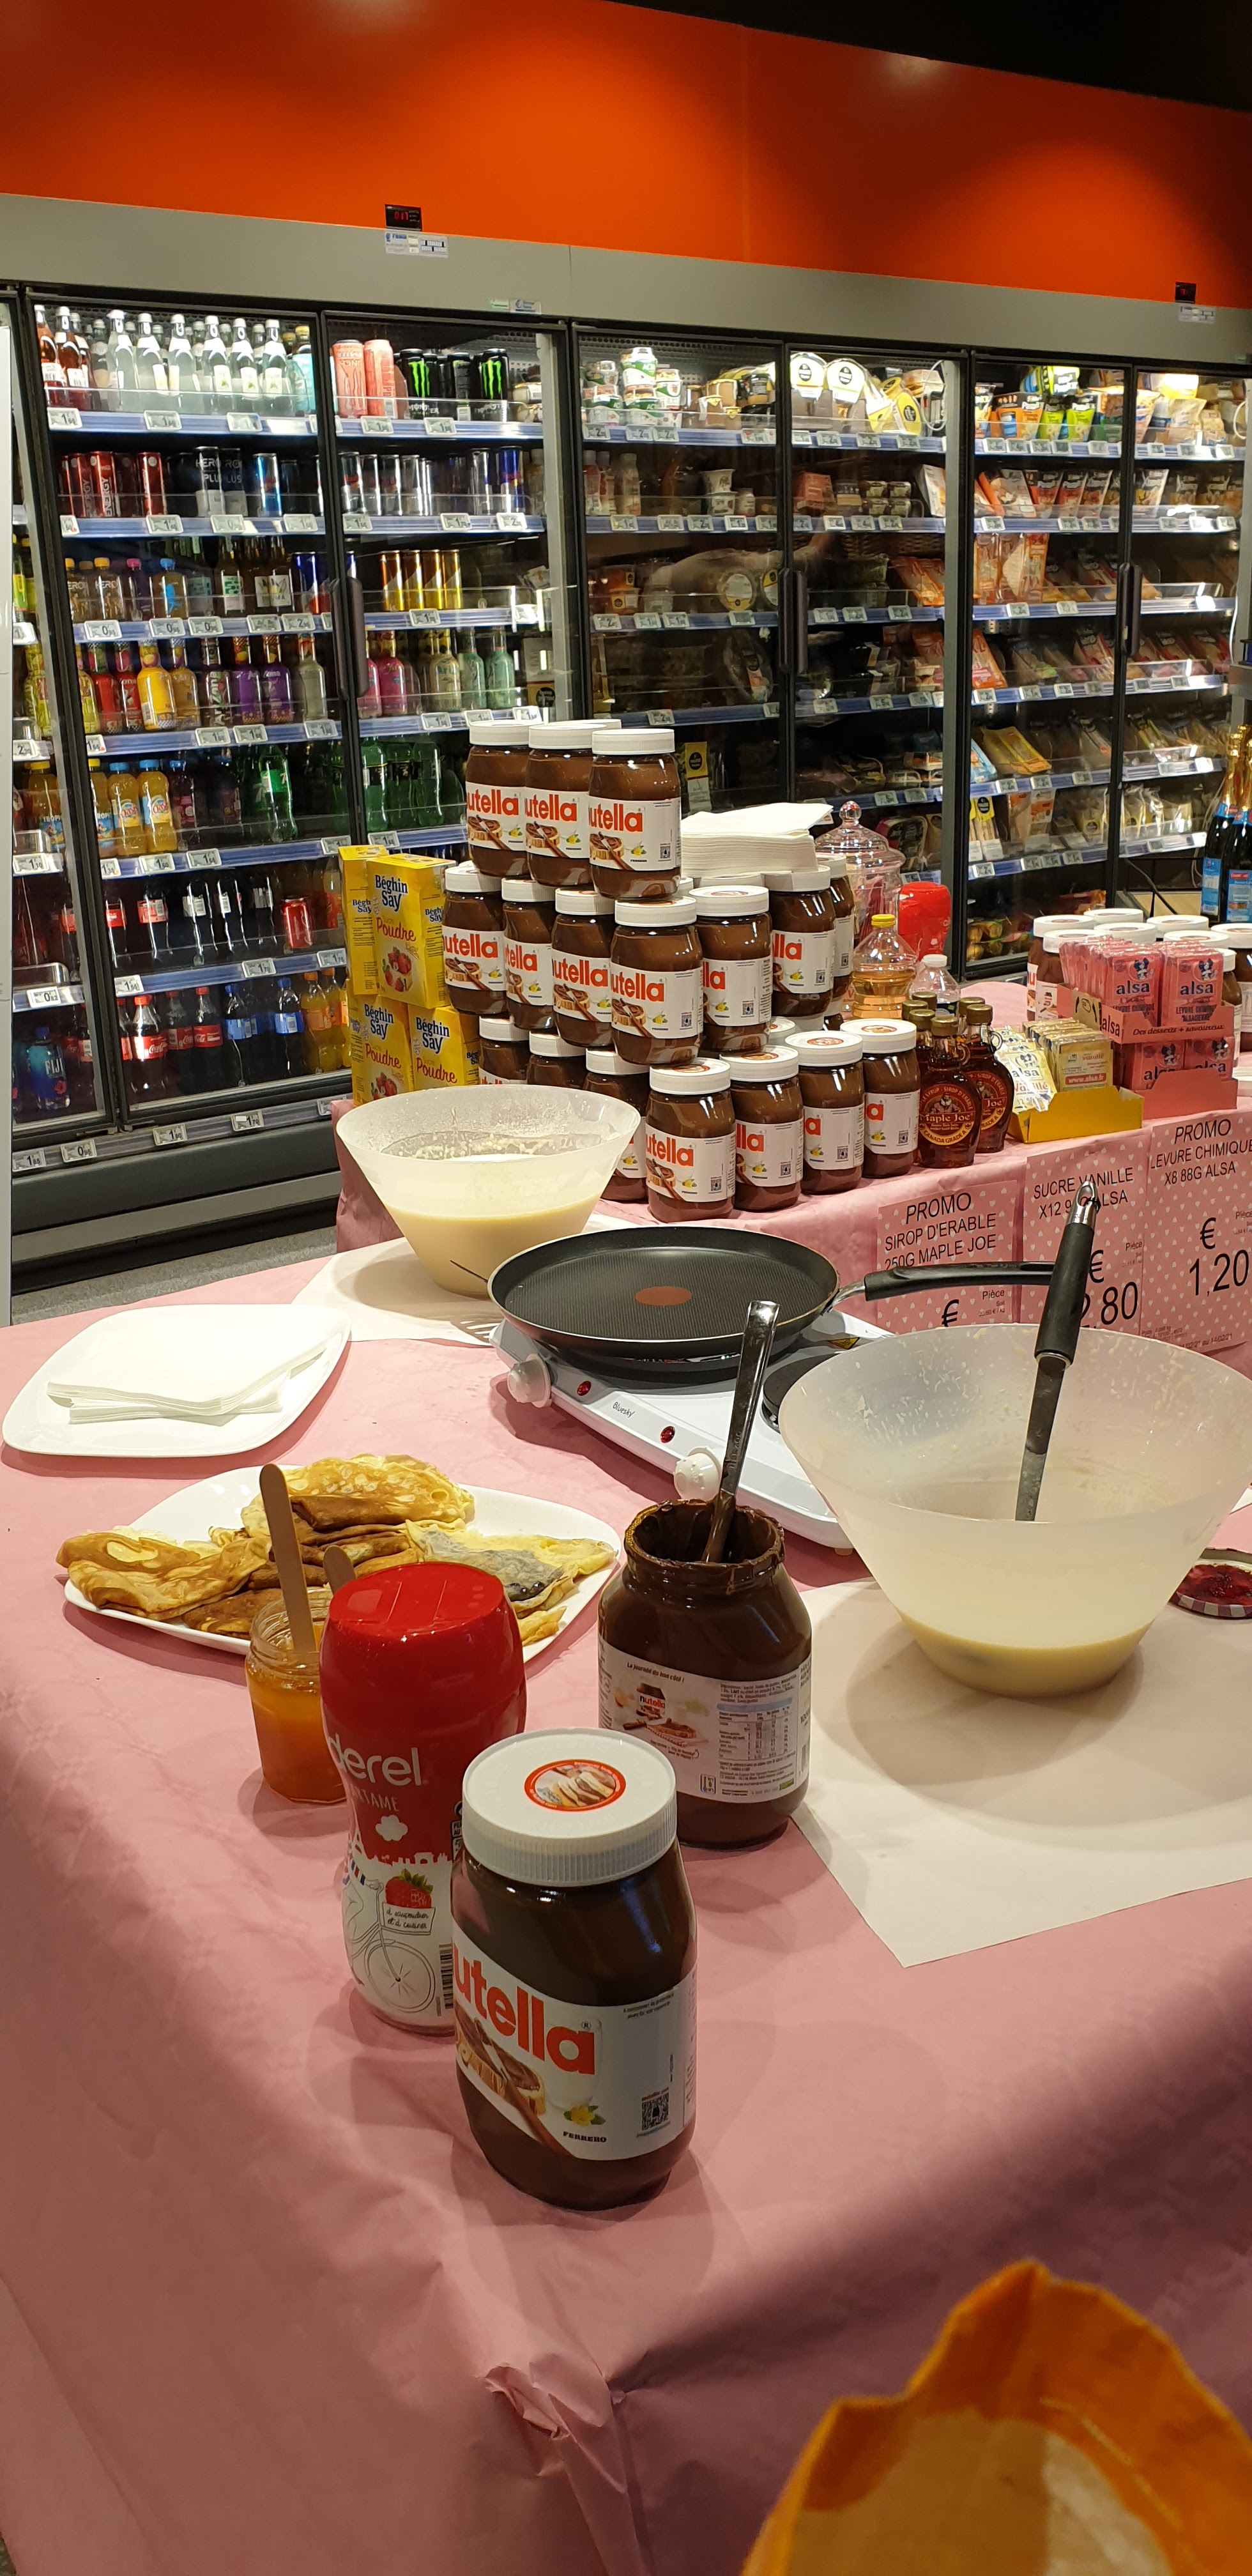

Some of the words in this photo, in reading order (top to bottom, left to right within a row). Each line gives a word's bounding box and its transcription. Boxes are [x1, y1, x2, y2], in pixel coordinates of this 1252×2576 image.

[375, 874, 408, 894] Béghin
[352, 898, 371, 908] Bégh
[381, 890, 402, 912] Say
[376, 916, 416, 942] Poudre
[443, 933, 499, 958] utella
[551, 957, 608, 988] utella
[1116, 979, 1150, 995] alsa
[1180, 981, 1214, 996] alsa
[364, 1003, 394, 1024] Béghin
[370, 1019, 389, 1040] Say
[415, 1016, 450, 1038] Béghin
[1102, 1015, 1120, 1037] alsa
[422, 1033, 444, 1055] Say
[365, 1043, 402, 1070] Poudre
[416, 1057, 458, 1084] Poudre
[986, 1099, 1003, 1107] Joe
[1174, 1118, 1232, 1145] PROMO
[1150, 1147, 1192, 1169] LEVURE
[1195, 1138, 1252, 1160] CHIMIQUE
[1164, 1170, 1177, 1186] X8
[1180, 1166, 1202, 1183] 88G
[1205, 1160, 1236, 1179] ALSA
[1033, 1177, 1076, 1200] SUCRE
[905, 1192, 972, 1225] PROMO
[1039, 1201, 1062, 1220] X12
[885, 1228, 924, 1252] SIROP
[928, 1213, 996, 1240] D'ERABLE
[1200, 1217, 1216, 1250] €
[919, 1239, 963, 1264] MAPLE
[967, 1234, 996, 1252] JOE
[1126, 1241, 1143, 1251] Pièce
[1090, 1249, 1104, 1284] €
[1189, 1249, 1249, 1297] 1,20
[982, 1289, 1005, 1300] Pièce
[941, 1299, 959, 1328] €
[612, 1401, 636, 1418] Bluesky
[453, 1941, 595, 2075] utella
[563, 2131, 607, 2143] FERRERO
